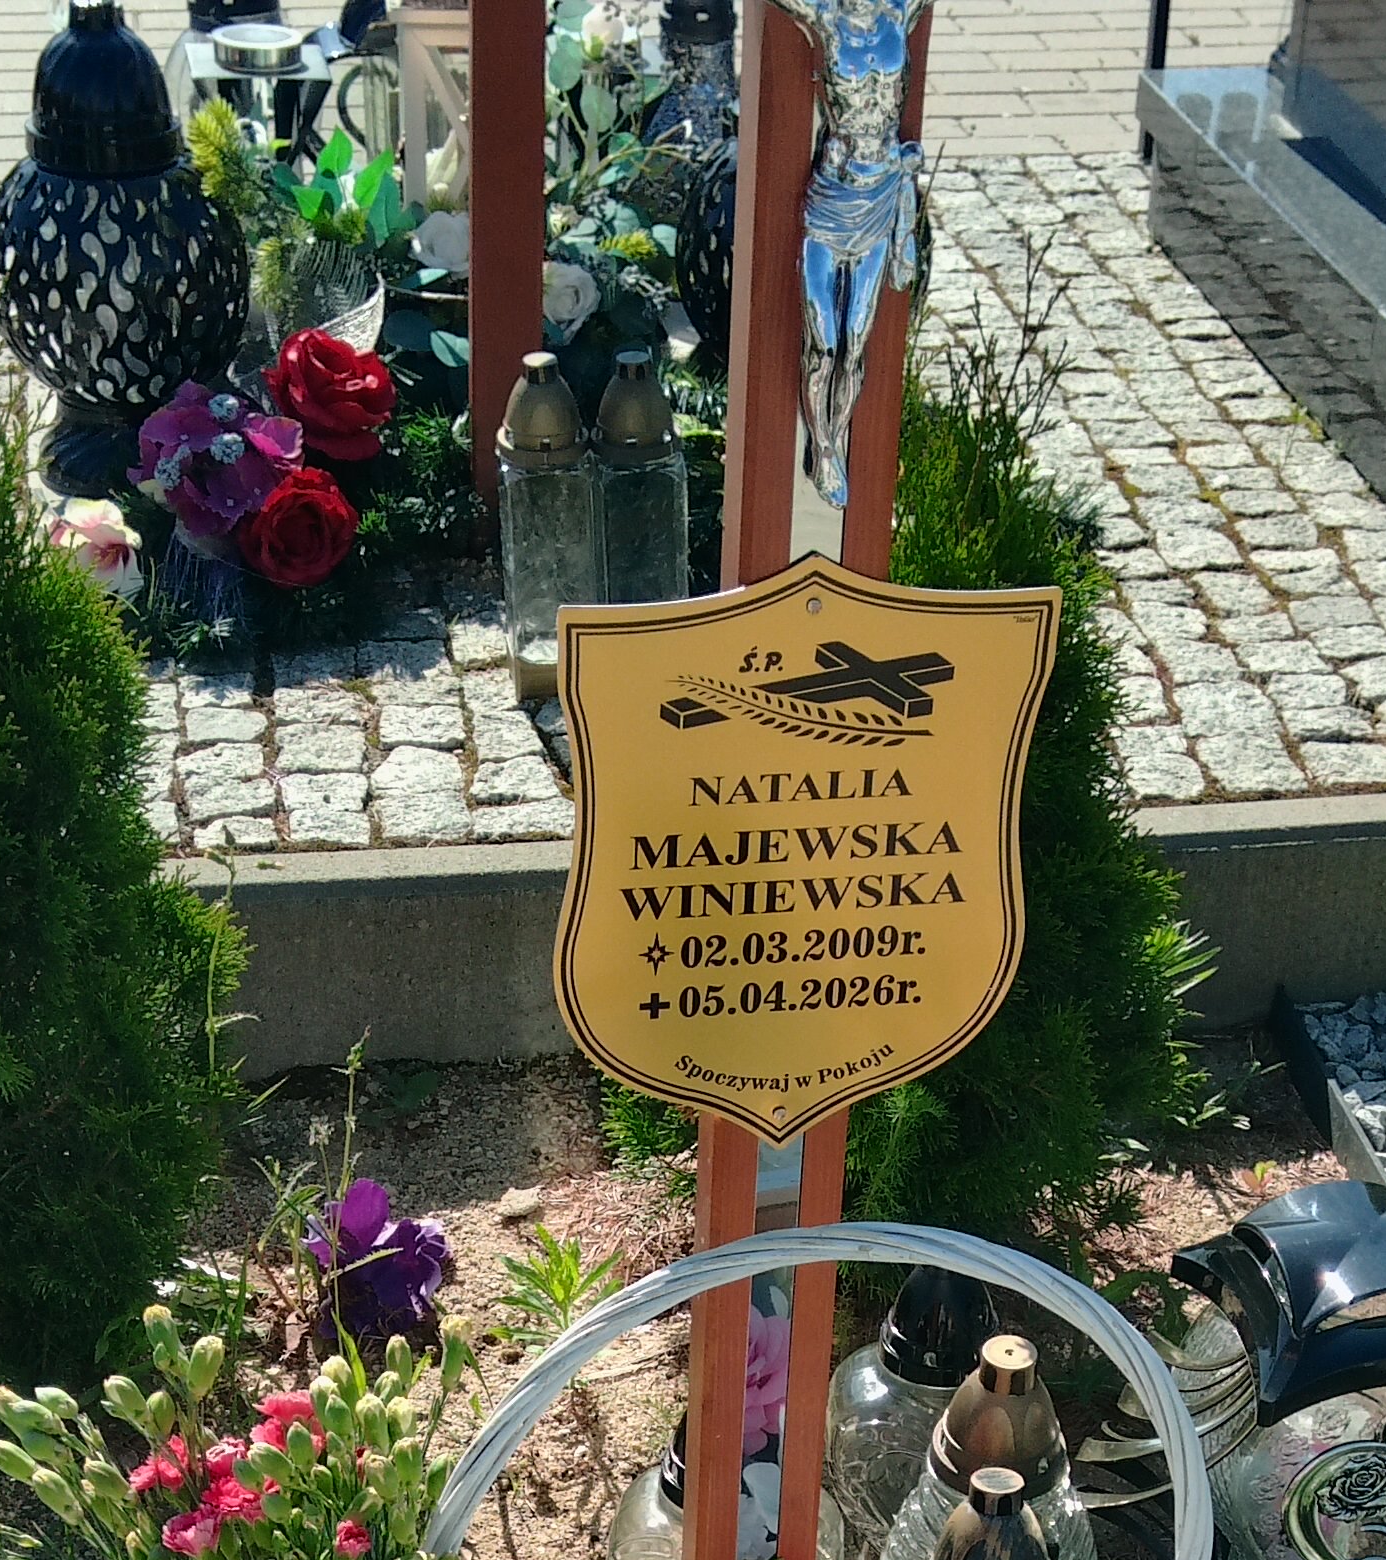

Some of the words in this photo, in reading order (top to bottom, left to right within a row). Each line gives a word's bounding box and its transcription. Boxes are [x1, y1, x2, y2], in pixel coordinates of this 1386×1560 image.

[738, 645, 784, 673] Ś.P.
[689, 768, 914, 807] NATALIA
[629, 821, 964, 871] MAJEWSKA
[619, 871, 967, 922] WINIEWSKA
[680, 926, 927, 969] 02.03.2009r.
[679, 975, 923, 1018] 05.04.2026r.
[674, 1054, 790, 1092] Spoczywaj
[794, 1075, 813, 1089] w
[817, 1043, 895, 1085] Pokoju
